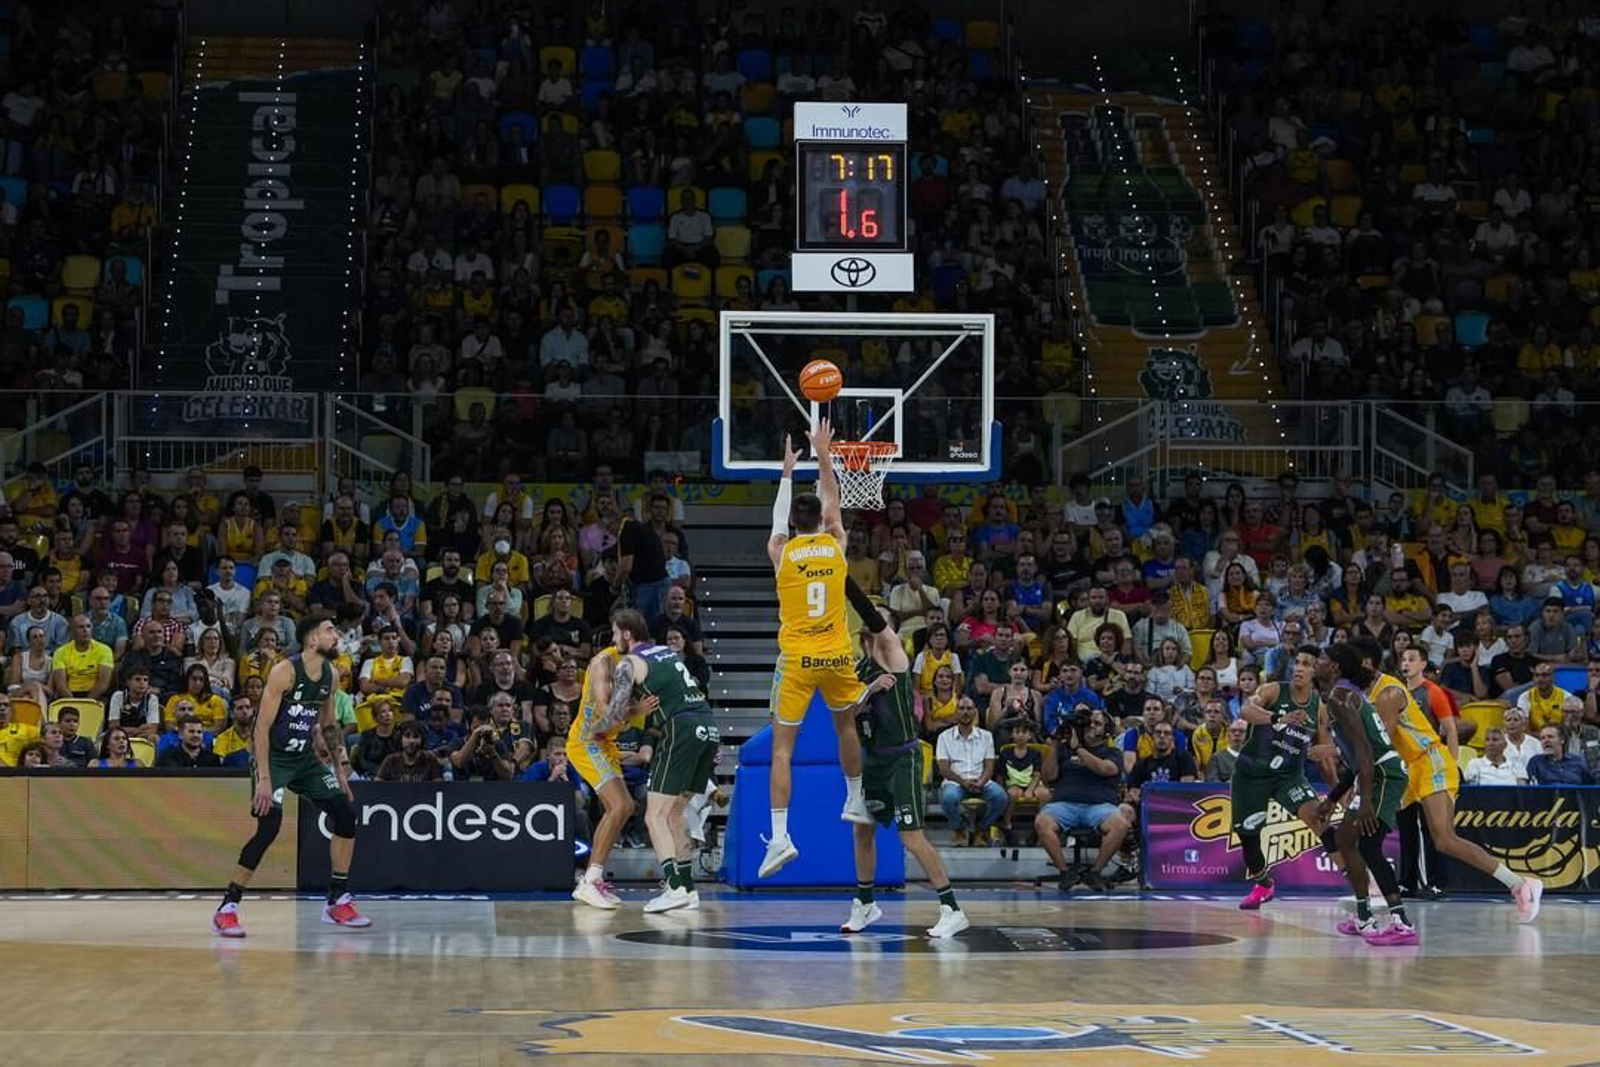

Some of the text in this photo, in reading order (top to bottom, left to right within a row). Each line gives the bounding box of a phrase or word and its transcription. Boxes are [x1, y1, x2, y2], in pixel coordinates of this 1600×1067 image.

[812, 124, 890, 139] Immunotec
[830, 154, 893, 180] 7:17
[215, 92, 305, 304] Tropical
[806, 581, 827, 618] 9
[1269, 755, 1284, 770] 0
[1161, 863, 1229, 876] tirma.com
